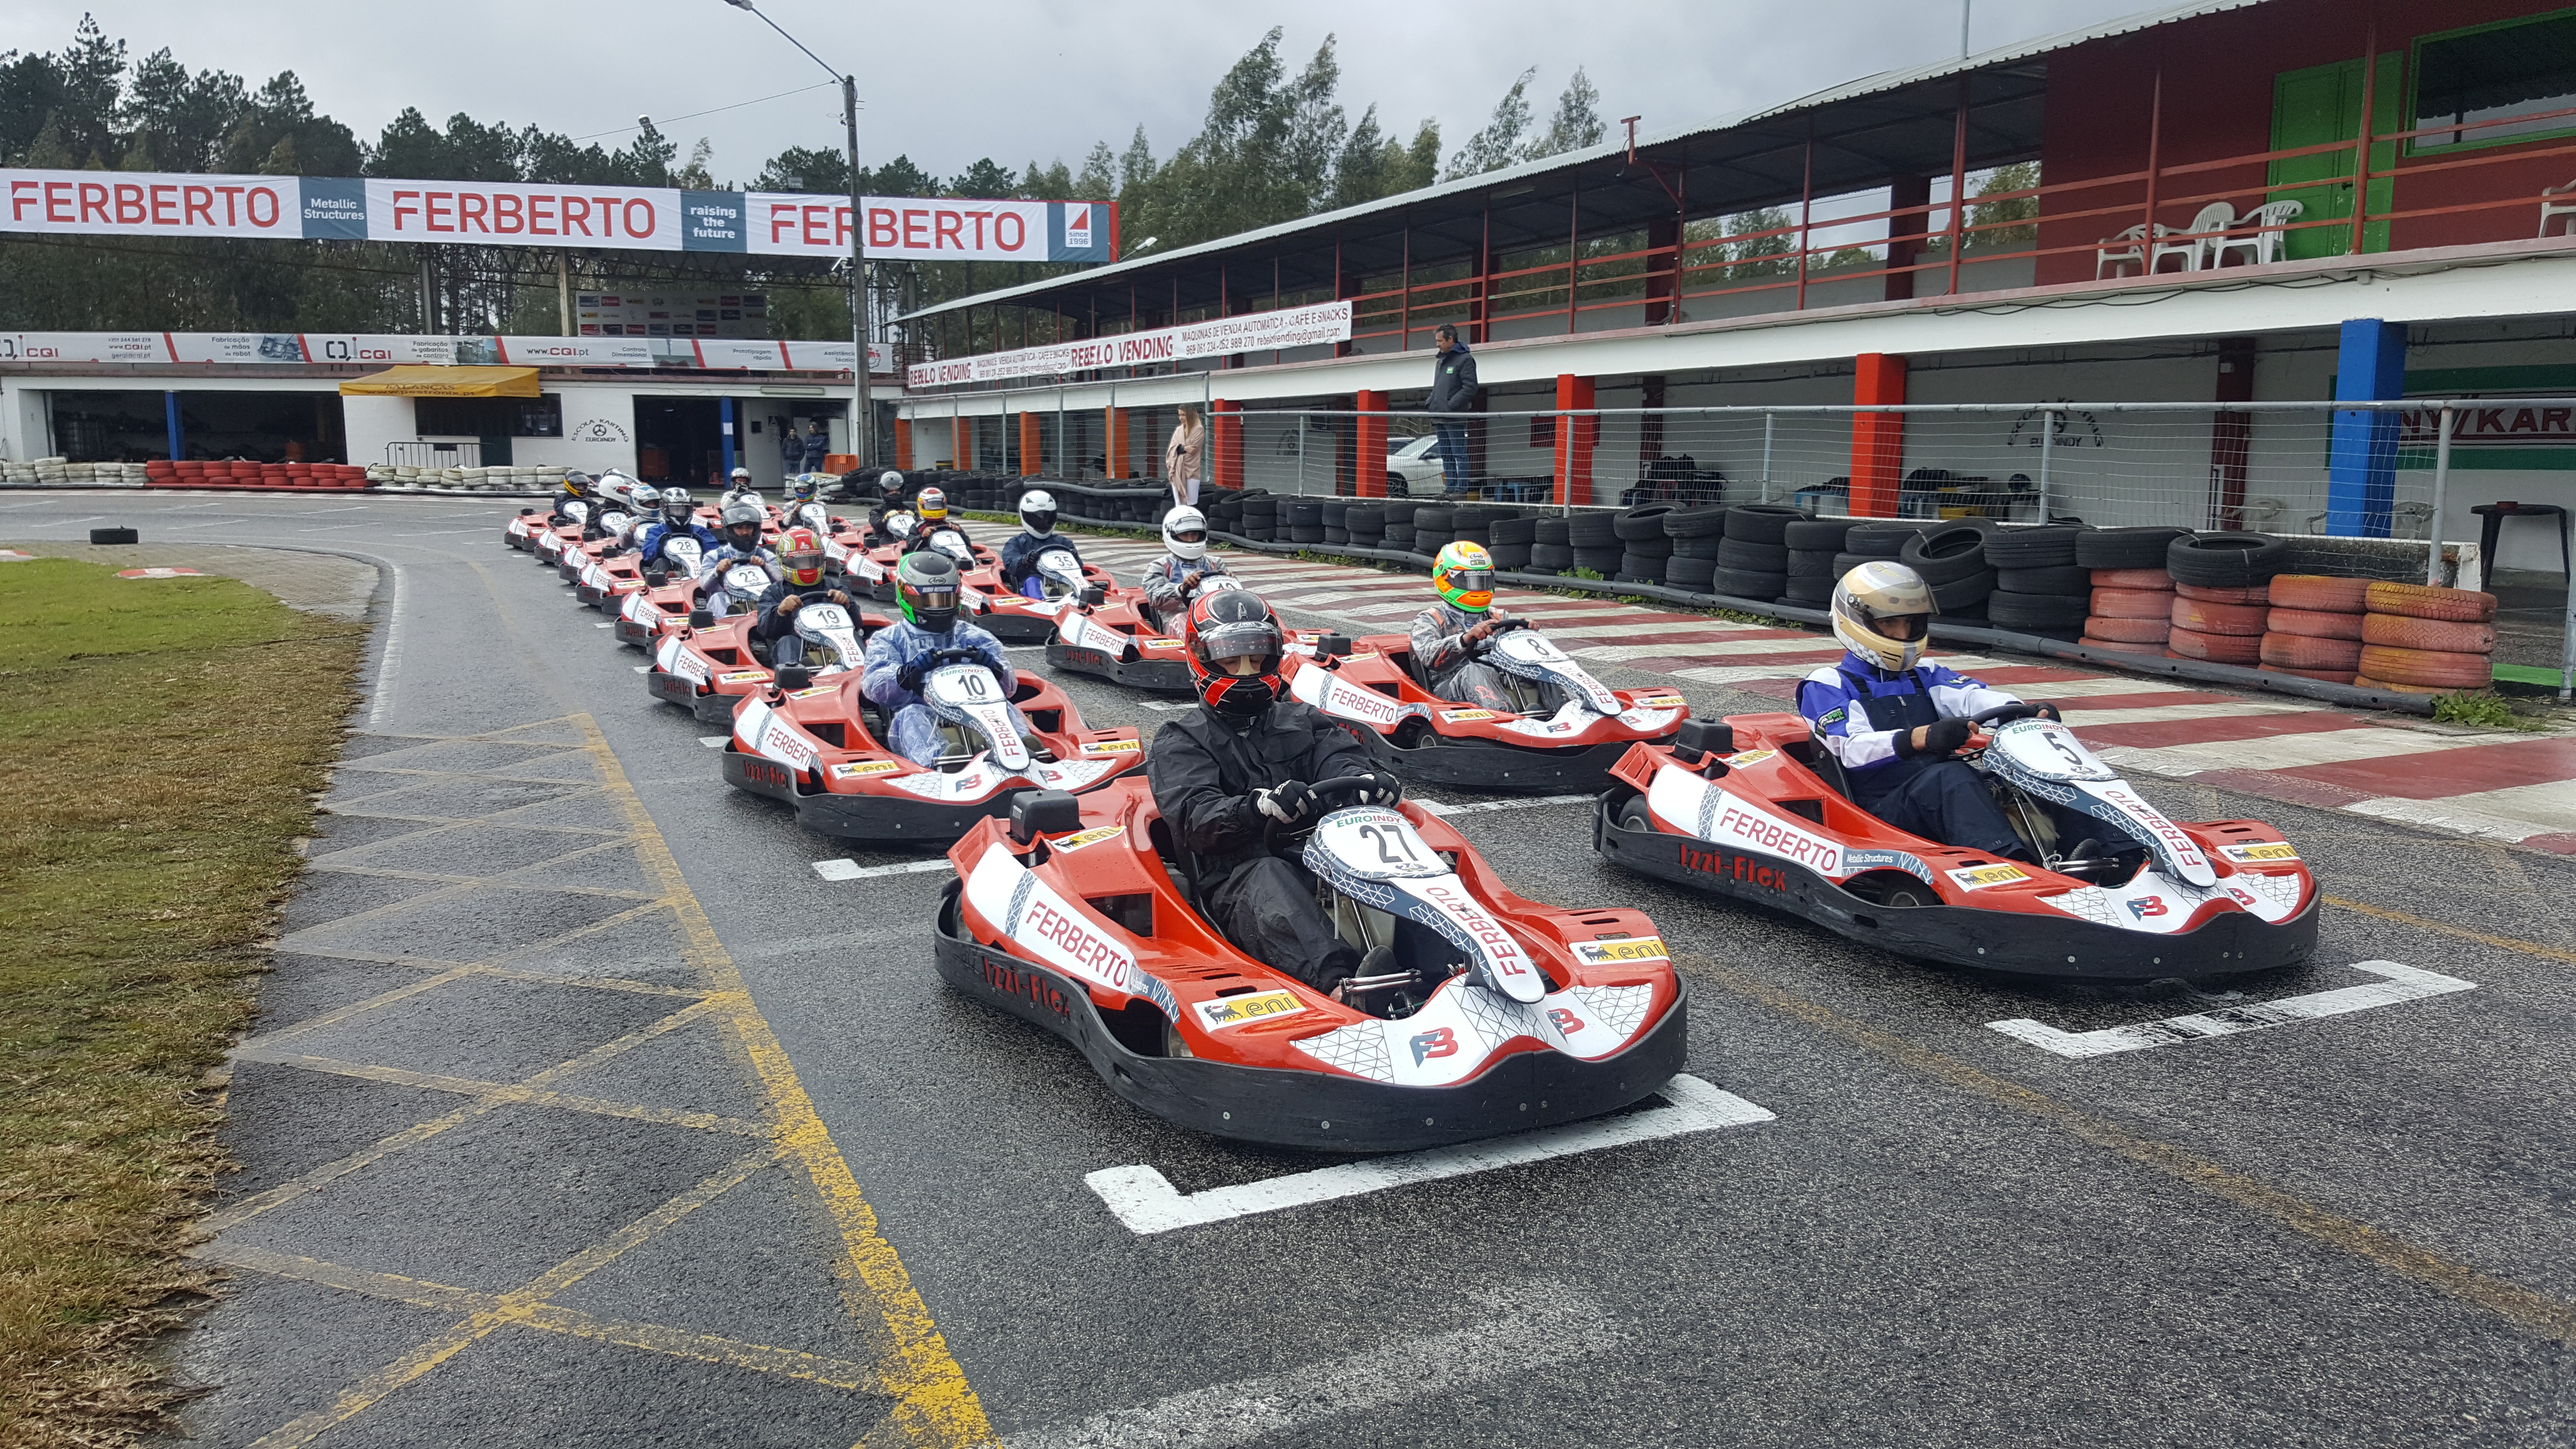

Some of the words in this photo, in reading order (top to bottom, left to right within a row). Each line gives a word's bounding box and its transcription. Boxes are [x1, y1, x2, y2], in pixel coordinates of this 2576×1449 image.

[11, 181, 279, 228] FERBERTO
[311, 198, 357, 210] Metallic
[690, 205, 737, 219] raising
[304, 208, 365, 221] Structures
[393, 191, 656, 239] FERBERTO
[703, 216, 725, 227] the
[693, 227, 736, 239] future
[771, 204, 1025, 252] FERBERTO
[1182, 328, 1212, 342] MÁQUINAS
[1213, 327, 1219, 338] DE
[1220, 323, 1242, 337] VENDA
[1243, 316, 1284, 333] AUTOMÁTICA
[1289, 310, 1310, 326] CAFÉ
[1311, 312, 1317, 324] E
[1318, 307, 1349, 323] SNACKS
[26, 348, 59, 357] CQI
[359, 350, 391, 359] CQI
[526, 347, 589, 357] www.CQI.pt
[1071, 344, 1113, 368] REBELO
[1119, 335, 1173, 363] VENDING
[909, 367, 936, 386] REBELO
[938, 362, 971, 382] VENDING
[2477, 408, 2576, 433] KAR
[571, 419, 595, 441] ESCOLA
[599, 419, 629, 443] KARTING
[610, 515, 622, 523] 29
[897, 518, 907, 527] 11
[676, 541, 693, 551] 28
[946, 535, 954, 545] 7
[1054, 556, 1073, 566] 35
[739, 571, 759, 583] 23
[818, 610, 840, 625] 19
[1084, 628, 1124, 653] FERBERTO
[1526, 638, 1550, 656] 8
[940, 668, 985, 677] EUROINDY
[958, 674, 986, 696] 10
[1559, 666, 1613, 705] FERBERTO
[1331, 687, 1395, 723] FERBERTO
[981, 709, 1020, 757] FERBERTO
[2012, 724, 2064, 735] EUROINDY
[1108, 742, 1137, 751] eni
[2042, 732, 2083, 766] 5
[1336, 815, 1401, 828] EUROINDY
[2105, 790, 2203, 867] FERBERTO
[1358, 824, 1419, 864] 27
[1719, 807, 1838, 872] FERBERTO
[1846, 854, 1864, 863] Metallic
[1864, 854, 1894, 863] Structures
[2259, 844, 2297, 860] eni
[1988, 864, 2025, 884] eni
[1426, 886, 1527, 977] FERBERTO
[1026, 900, 1128, 987] FERBERTO
[1618, 942, 1667, 961] eni
[1244, 991, 1300, 1018] eni
